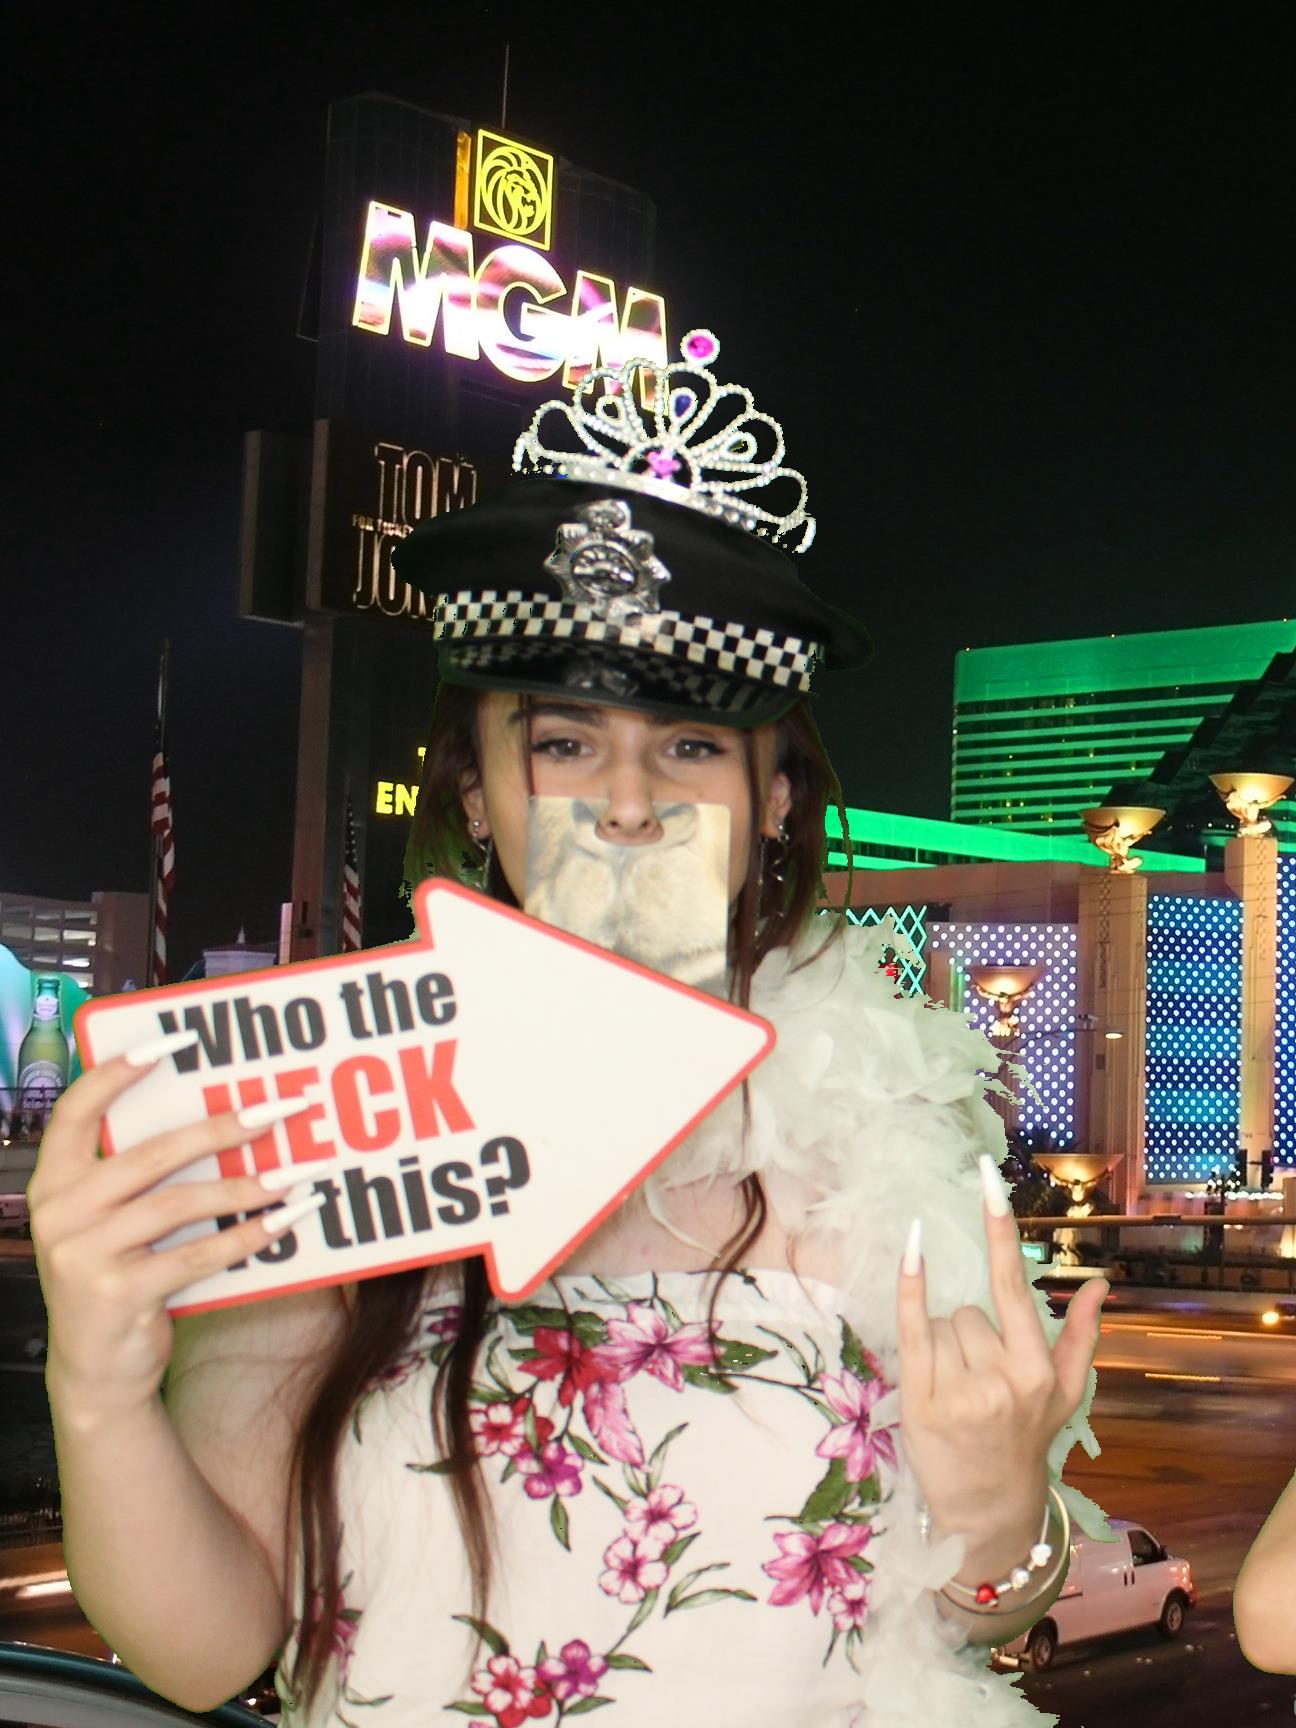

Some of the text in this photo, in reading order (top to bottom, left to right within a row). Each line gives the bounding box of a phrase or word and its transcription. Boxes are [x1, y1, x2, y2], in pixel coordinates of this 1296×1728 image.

[352, 200, 669, 416] MGM
[374, 442, 478, 528] TOM
[157, 971, 459, 1075] Who the
[202, 1038, 478, 1181] HECK
[311, 1136, 532, 1250] this?
